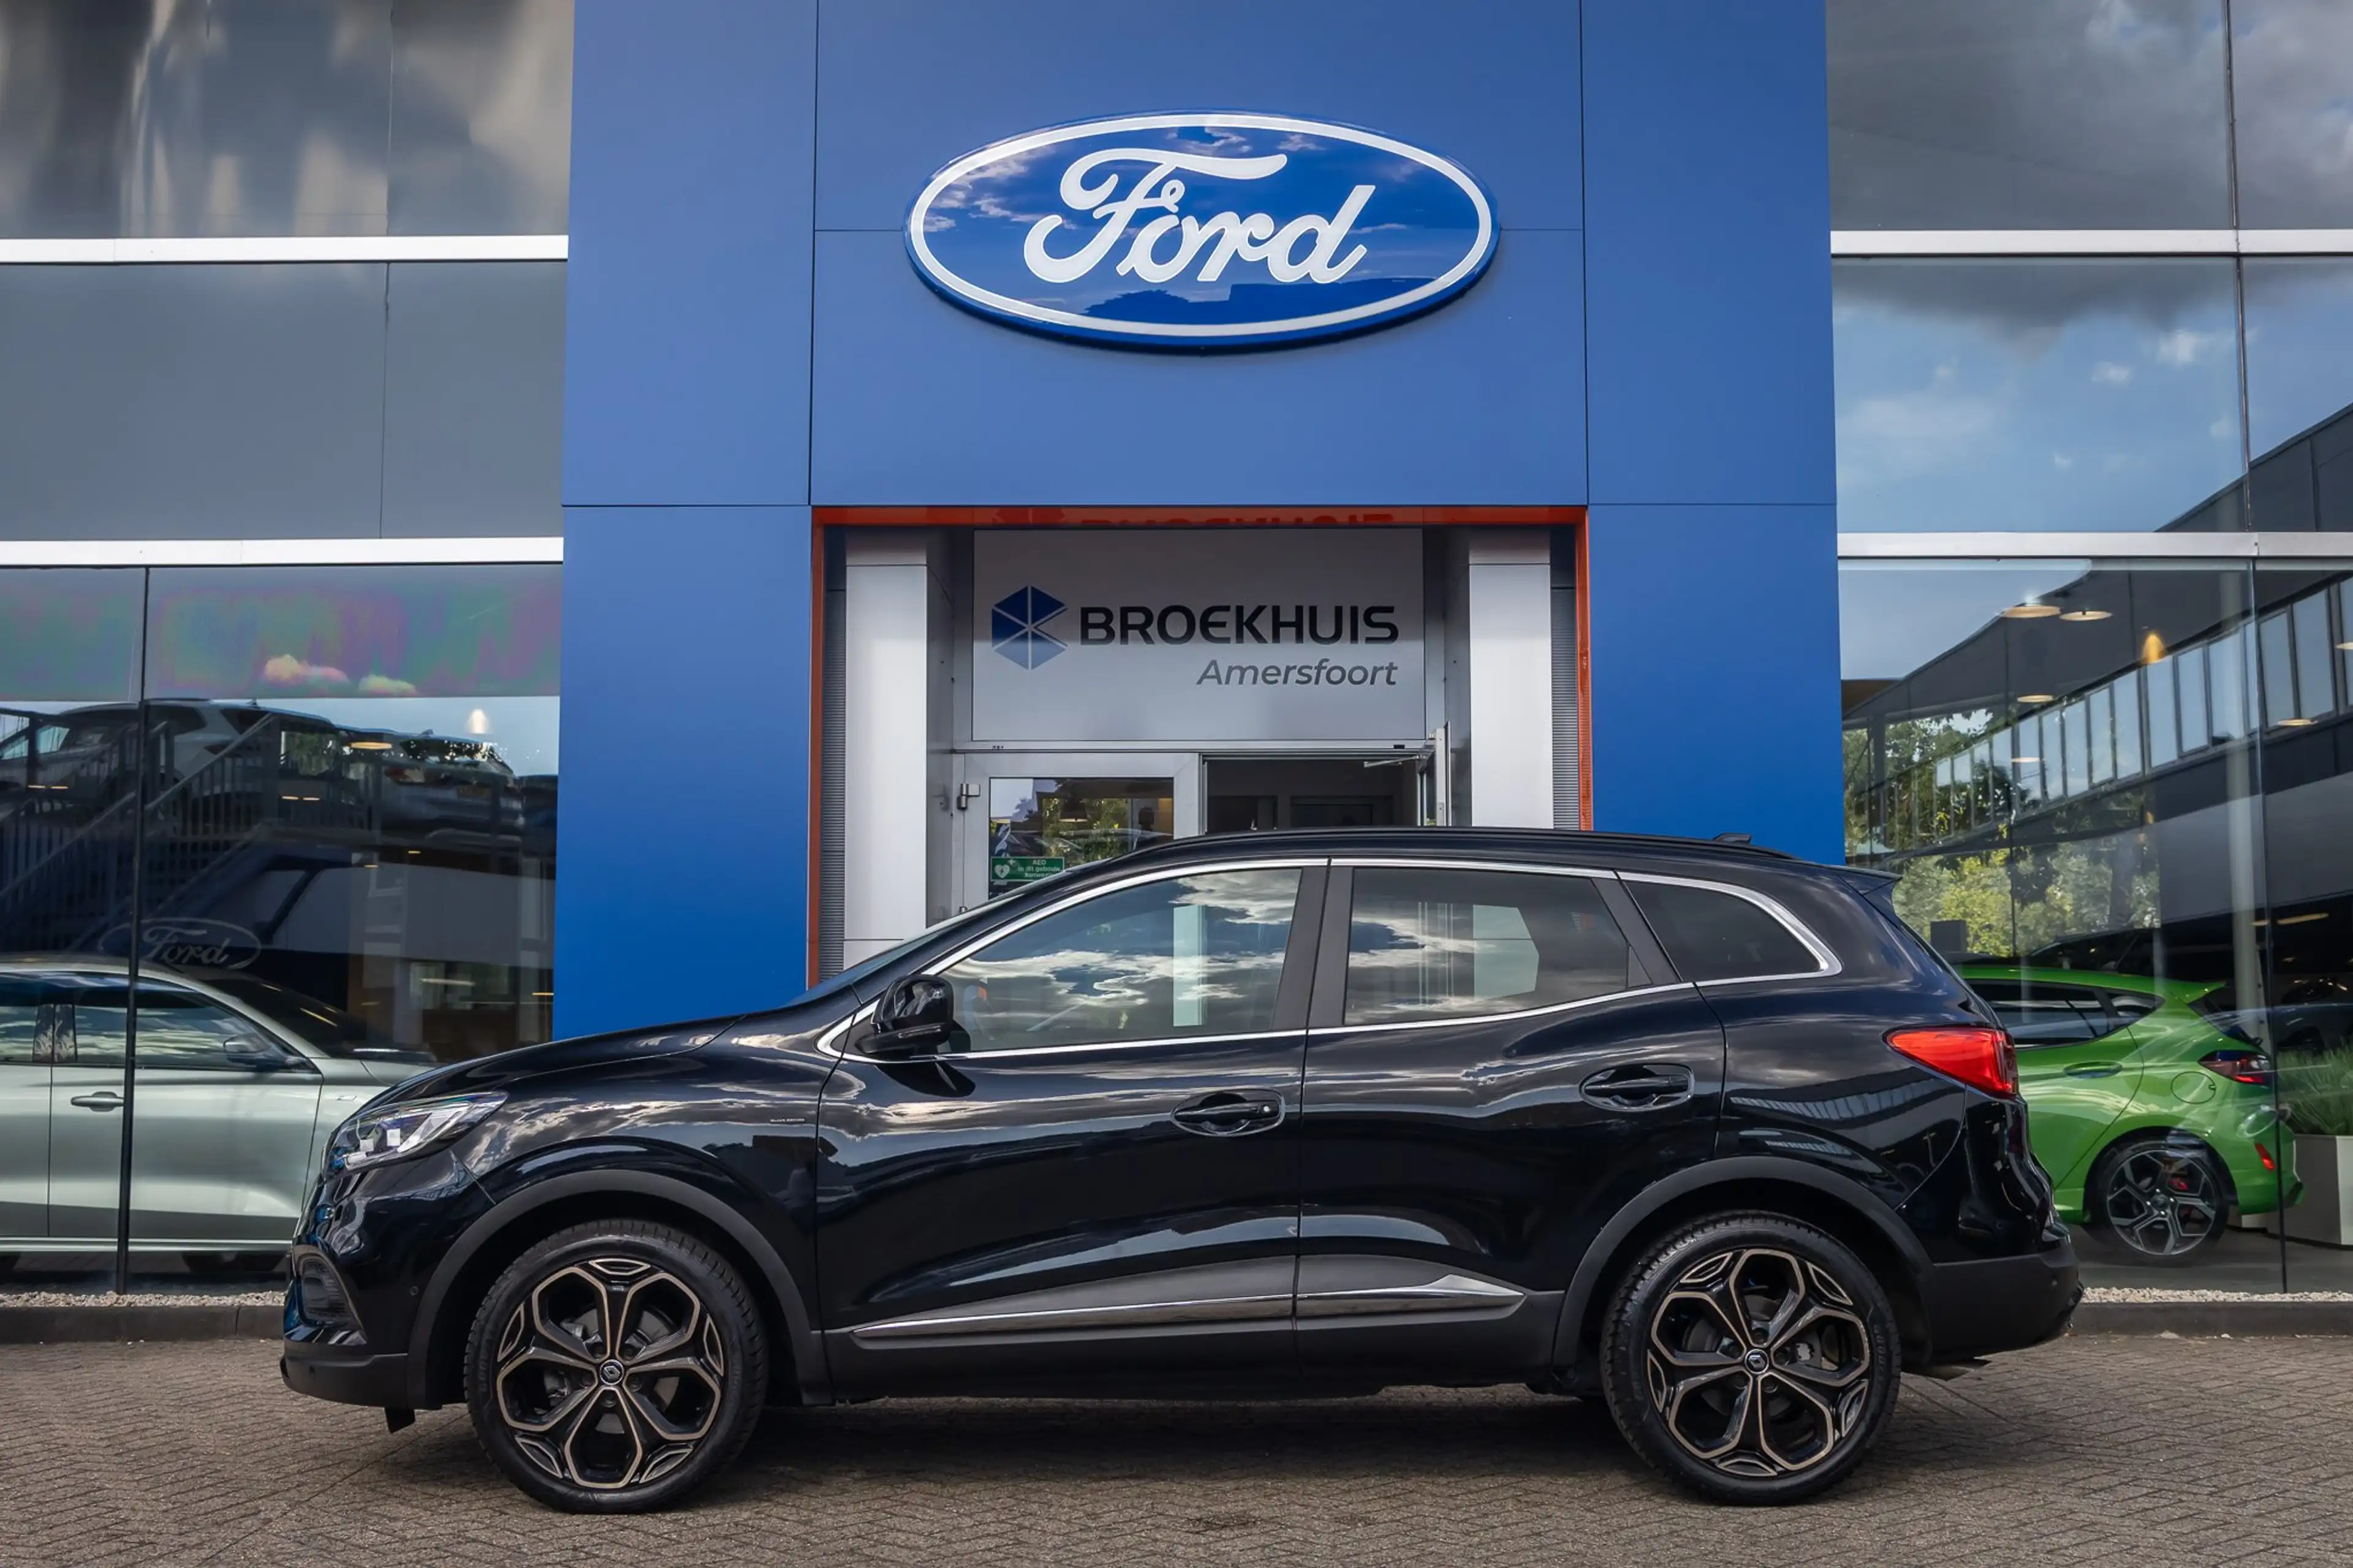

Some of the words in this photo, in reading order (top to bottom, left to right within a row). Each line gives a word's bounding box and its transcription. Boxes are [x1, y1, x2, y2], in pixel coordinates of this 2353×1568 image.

[1024, 148, 1376, 283] Ford
[1080, 604, 1399, 645] BROEKHUIS
[1196, 658, 1398, 686] Amersfoort
[142, 926, 232, 964] Ford
